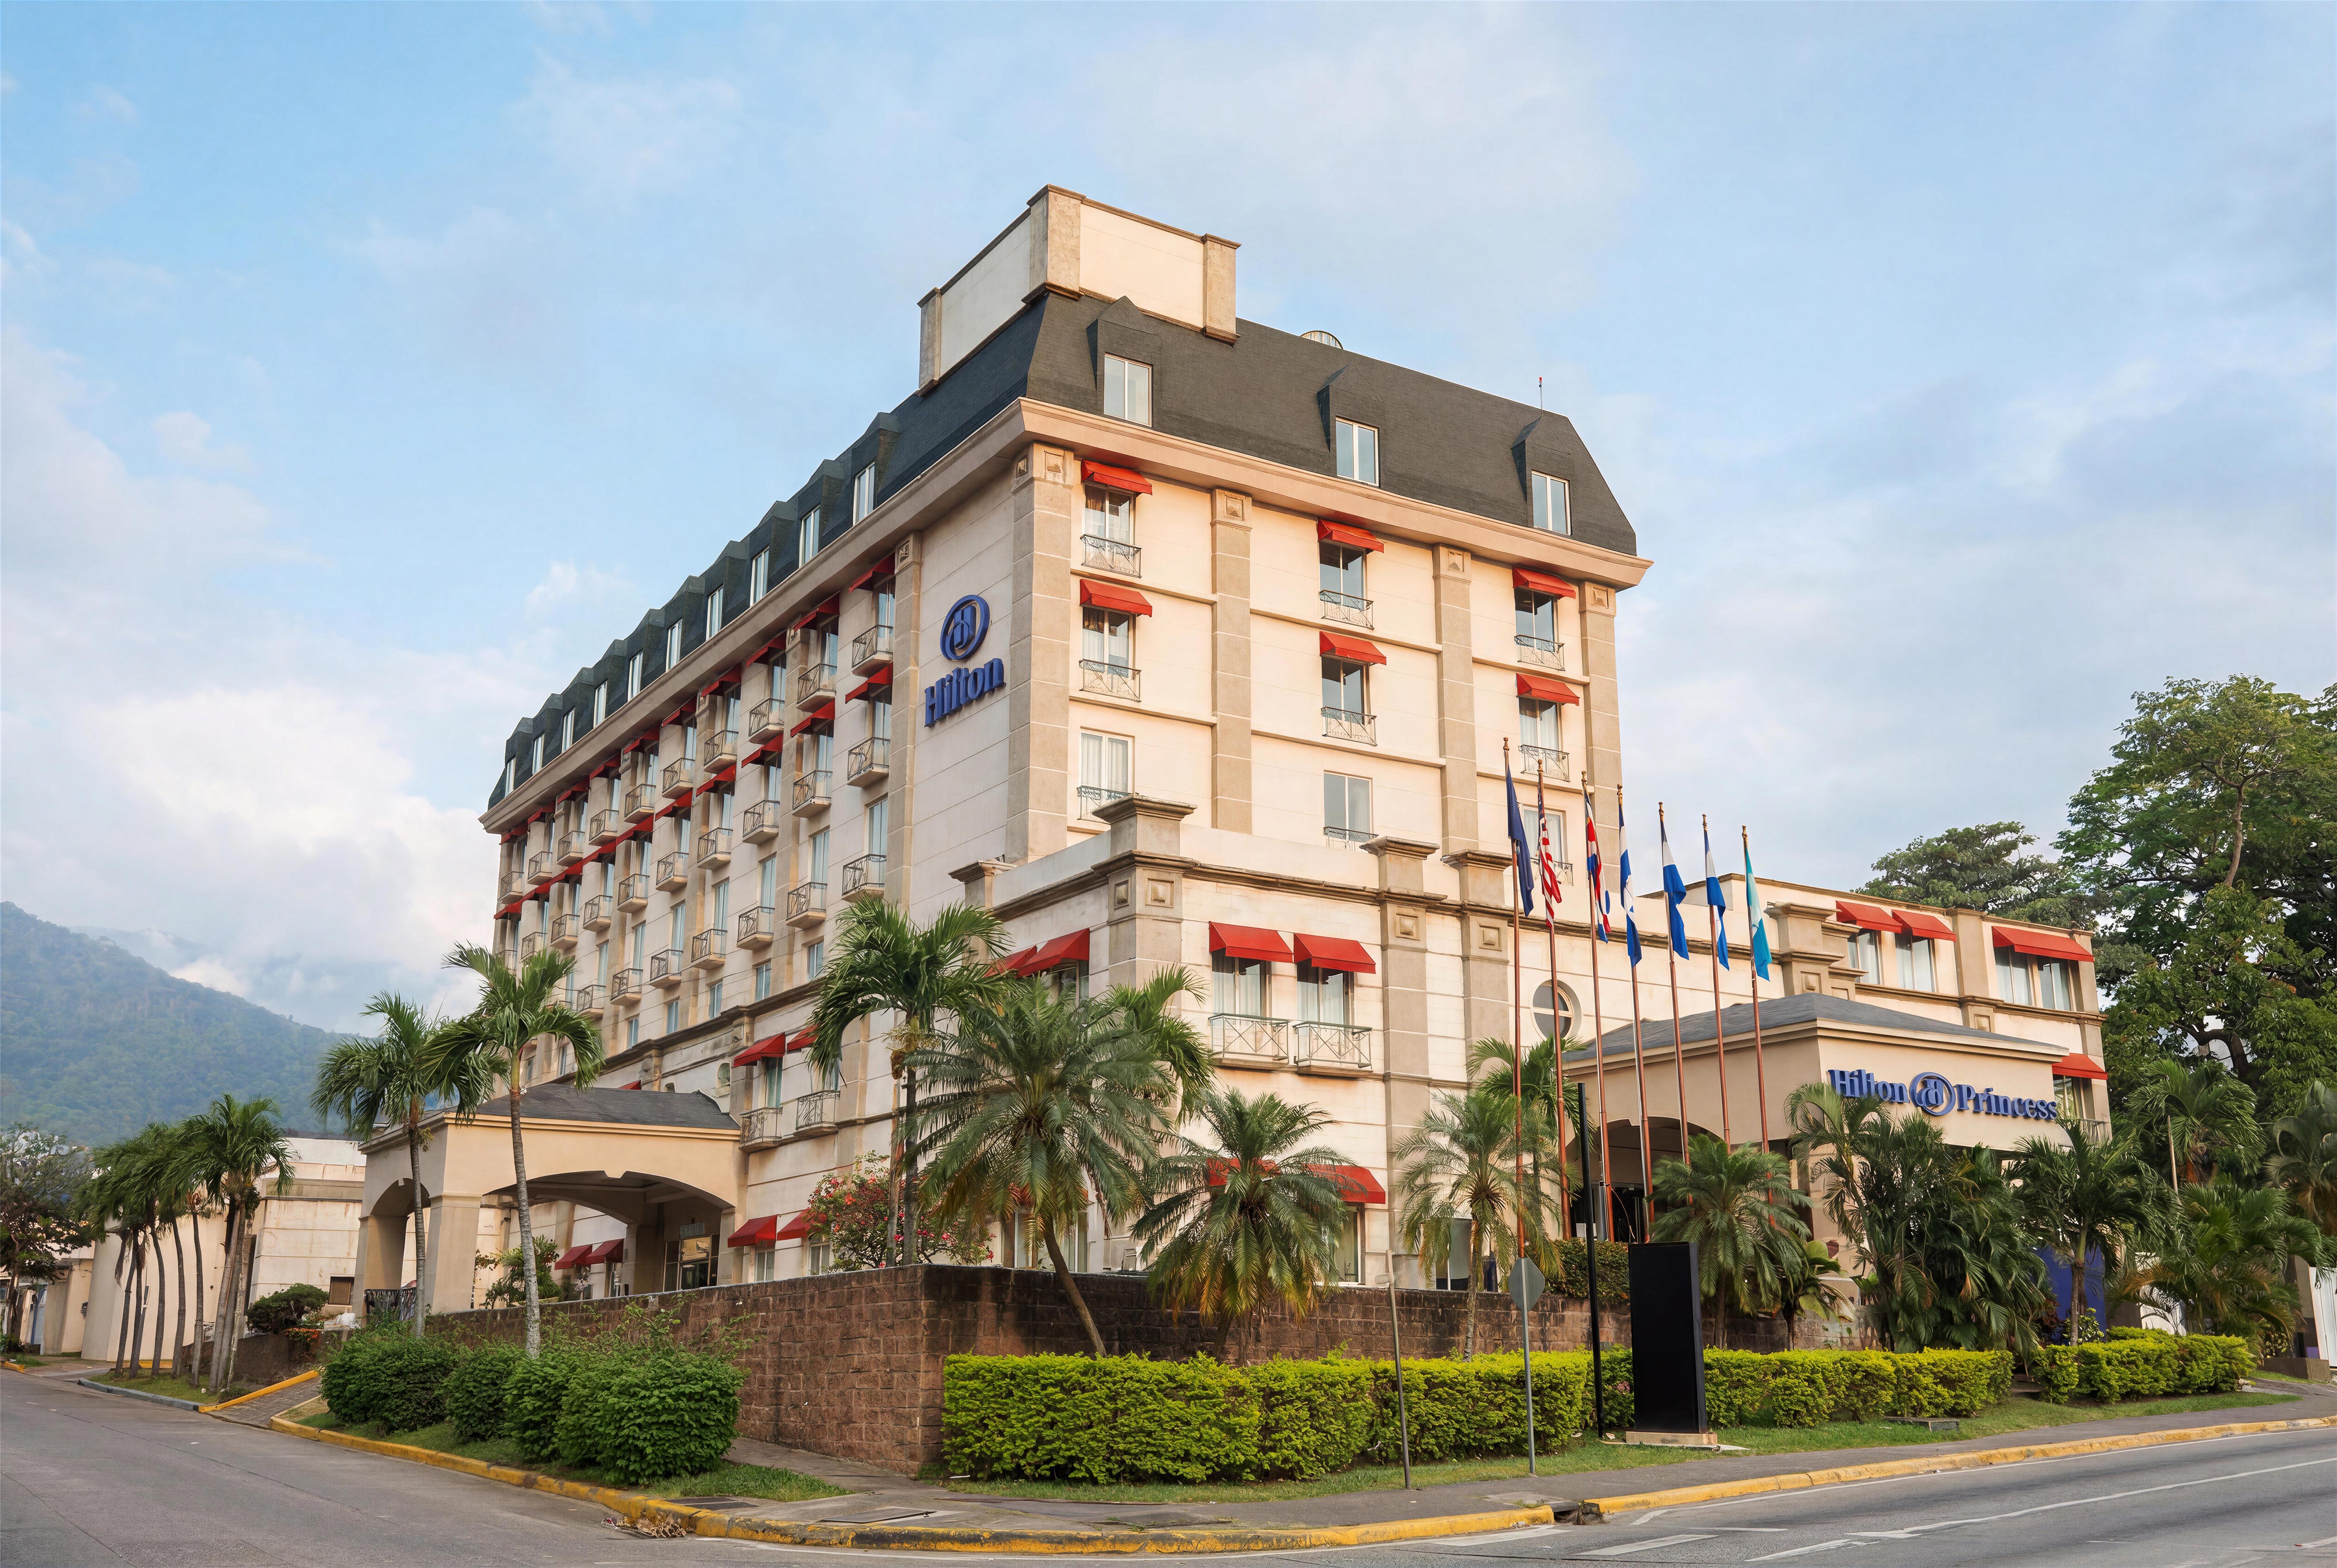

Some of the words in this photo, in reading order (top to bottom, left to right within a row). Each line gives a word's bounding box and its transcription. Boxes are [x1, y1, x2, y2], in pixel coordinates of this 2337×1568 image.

[924, 658, 1006, 728] Hilton
[1828, 1069, 1910, 1103] Hilton
[1954, 1084, 2057, 1120] Princess
